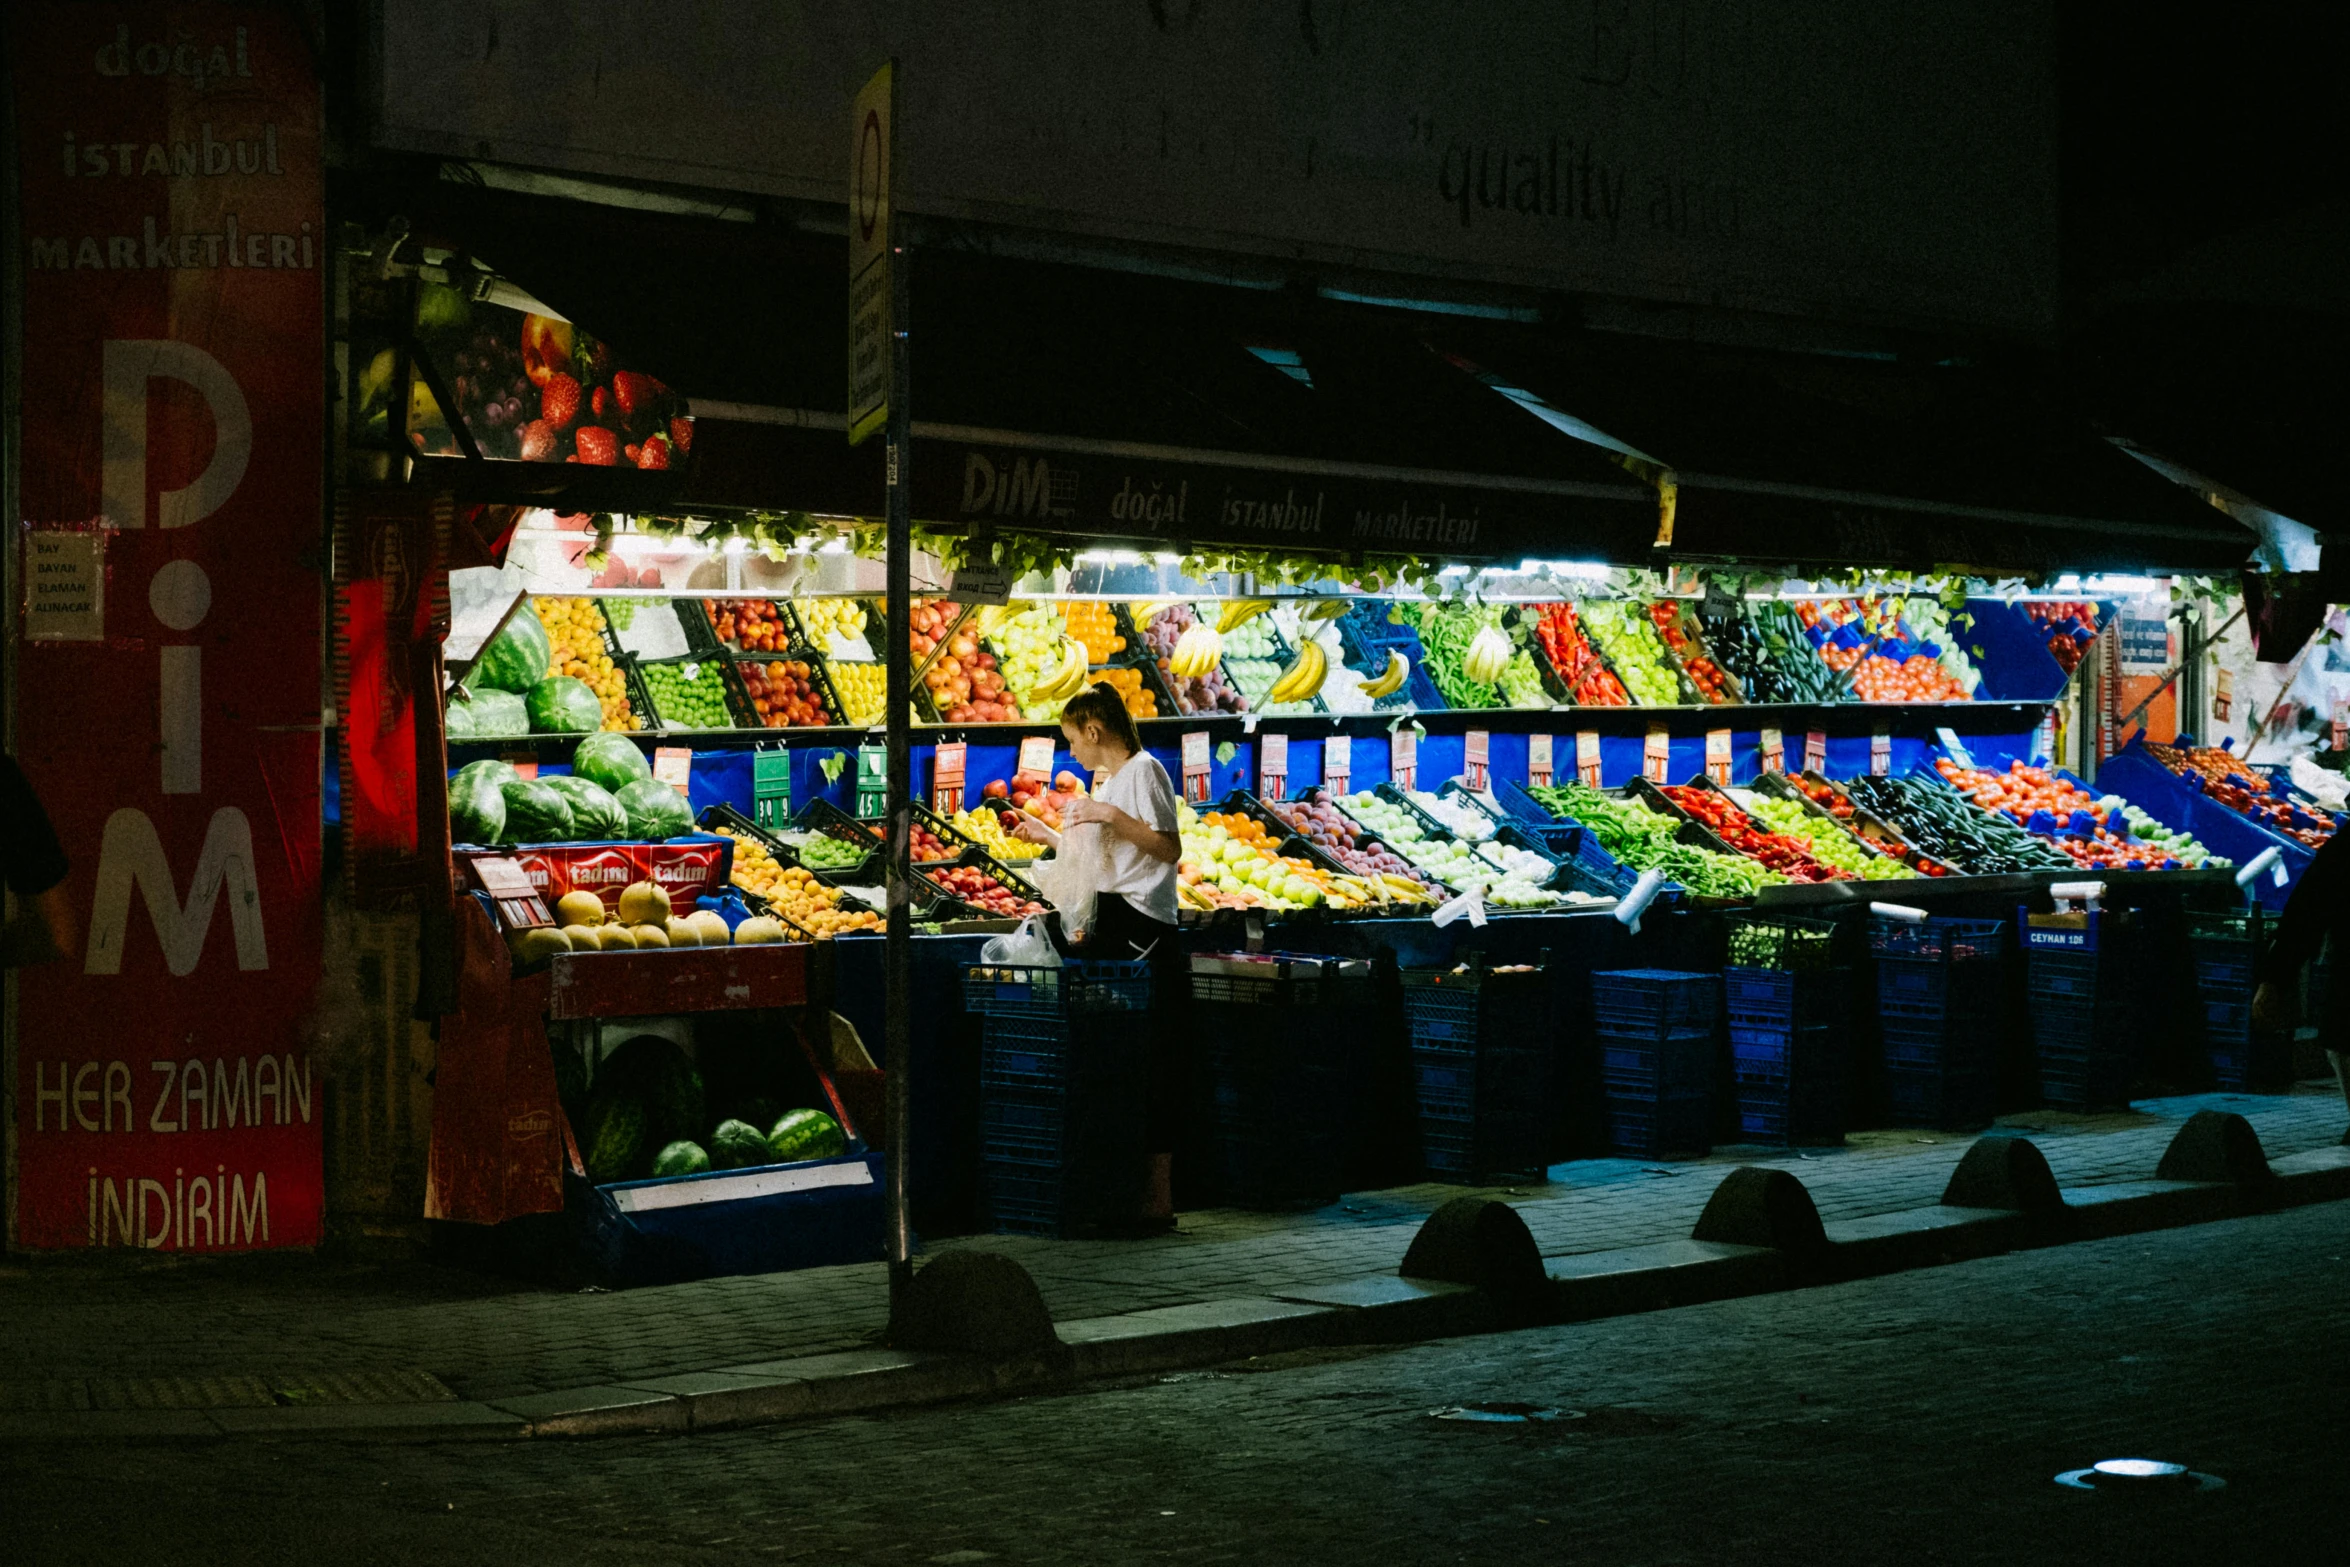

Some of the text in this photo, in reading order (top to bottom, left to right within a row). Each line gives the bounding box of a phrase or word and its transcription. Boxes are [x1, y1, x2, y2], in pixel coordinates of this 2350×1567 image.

[37, 544, 59, 553] BAY
[37, 563, 76, 573] BAYAN
[957, 582, 979, 593] ВХОД
[35, 602, 91, 613] ALINACAK
[570, 862, 628, 884] tadım
[653, 861, 707, 882] tadım
[2030, 932, 2066, 944] CEYHAN
[36, 1053, 312, 1133] HER ZAMAN
